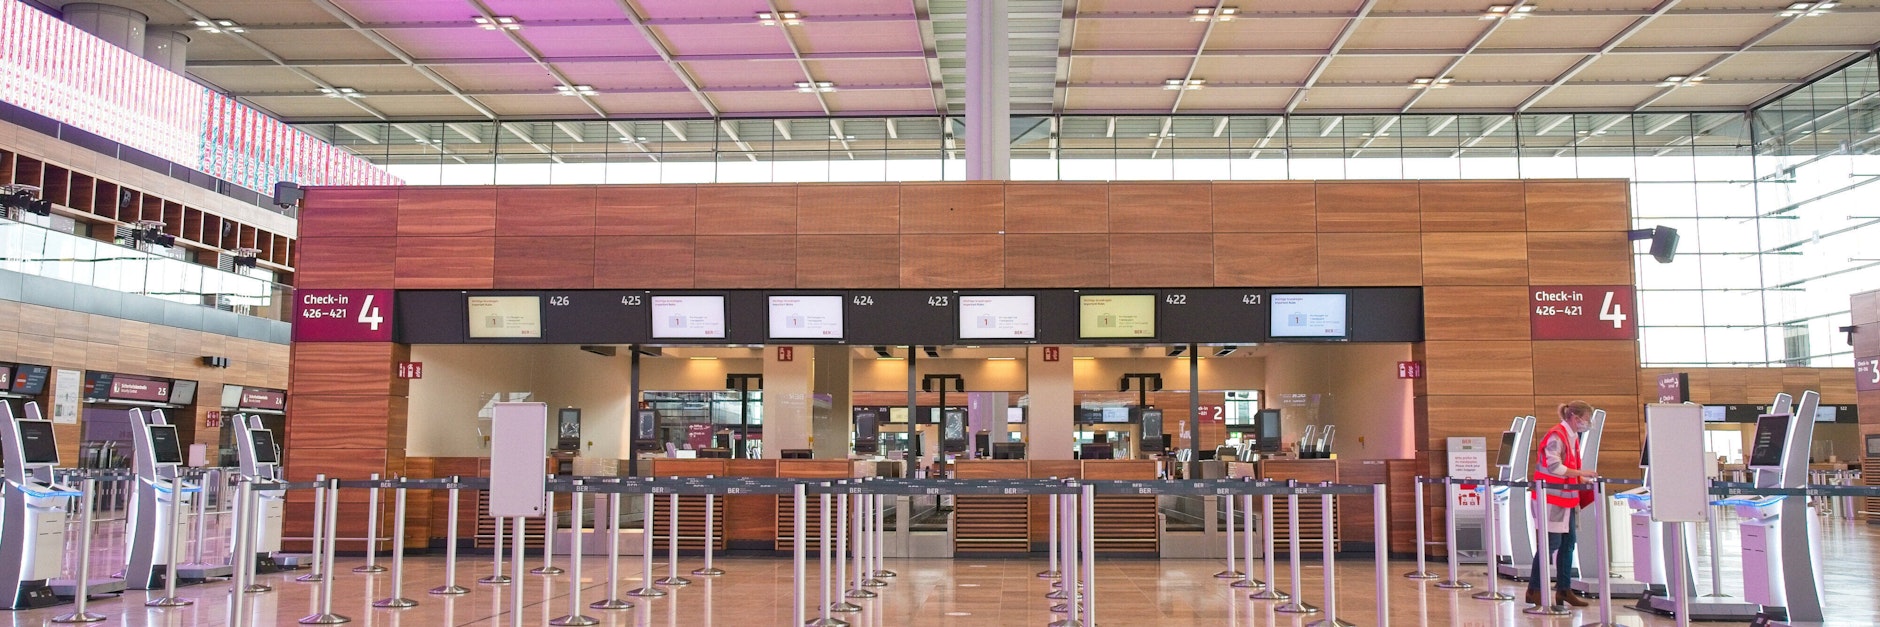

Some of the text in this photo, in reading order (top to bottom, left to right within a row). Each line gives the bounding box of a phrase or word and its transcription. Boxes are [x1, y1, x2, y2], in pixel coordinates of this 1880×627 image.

[304, 294, 348, 304] Check-in
[550, 296, 569, 305] 426
[621, 296, 641, 305] 425
[854, 296, 873, 305] 424
[1166, 295, 1186, 304] 422
[1242, 295, 1261, 304] 421
[1535, 291, 1583, 302] Check-in
[928, 297, 948, 306] 423
[358, 295, 383, 330] 4
[1600, 292, 1626, 328] 4
[1871, 360, 1880, 383] 3
[1214, 406, 1222, 420] 2
